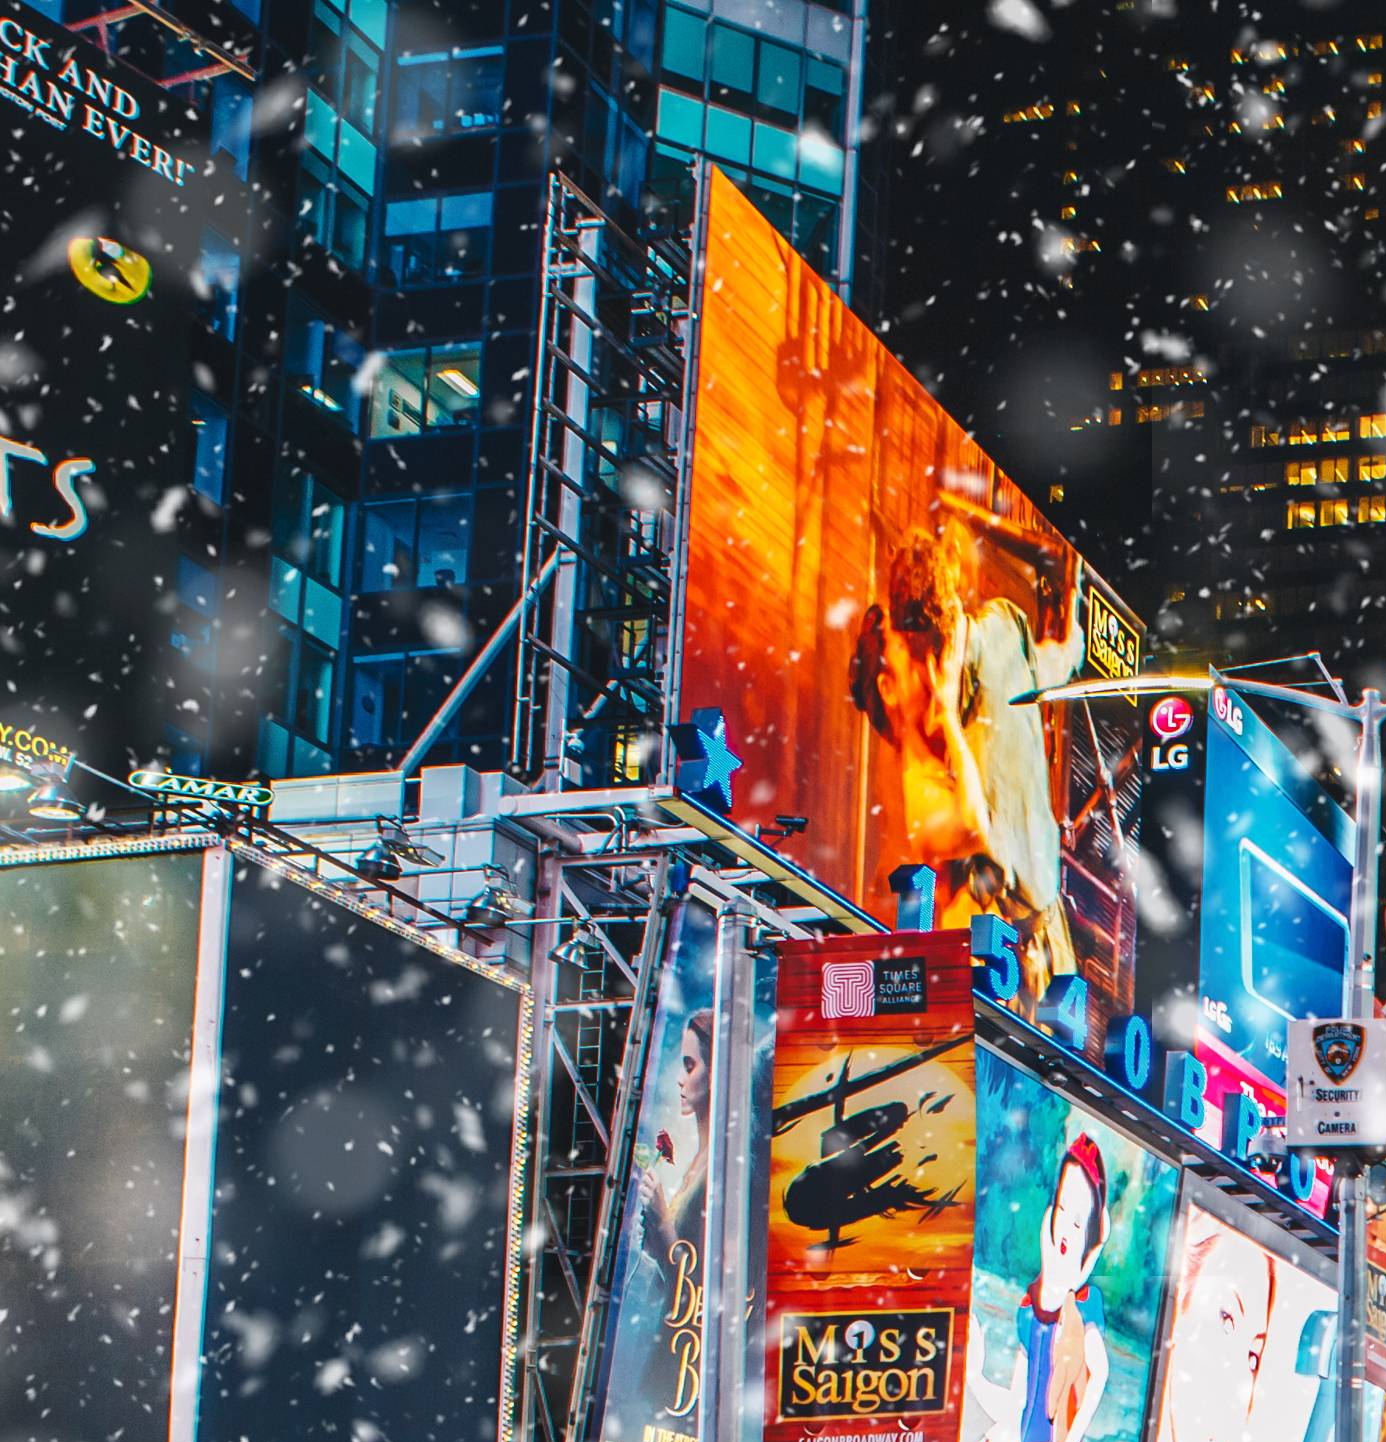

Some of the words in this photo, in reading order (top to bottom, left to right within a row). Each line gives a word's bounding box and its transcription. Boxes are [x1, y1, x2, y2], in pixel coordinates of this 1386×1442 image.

[57, 58, 141, 120] AND
[1151, 744, 1189, 772] LG
[883, 970, 918, 981] TIMES
[879, 983, 922, 995] SQUARE
[1317, 1121, 1356, 1134] CAMERA
[791, 1365, 938, 1413] Saigon
